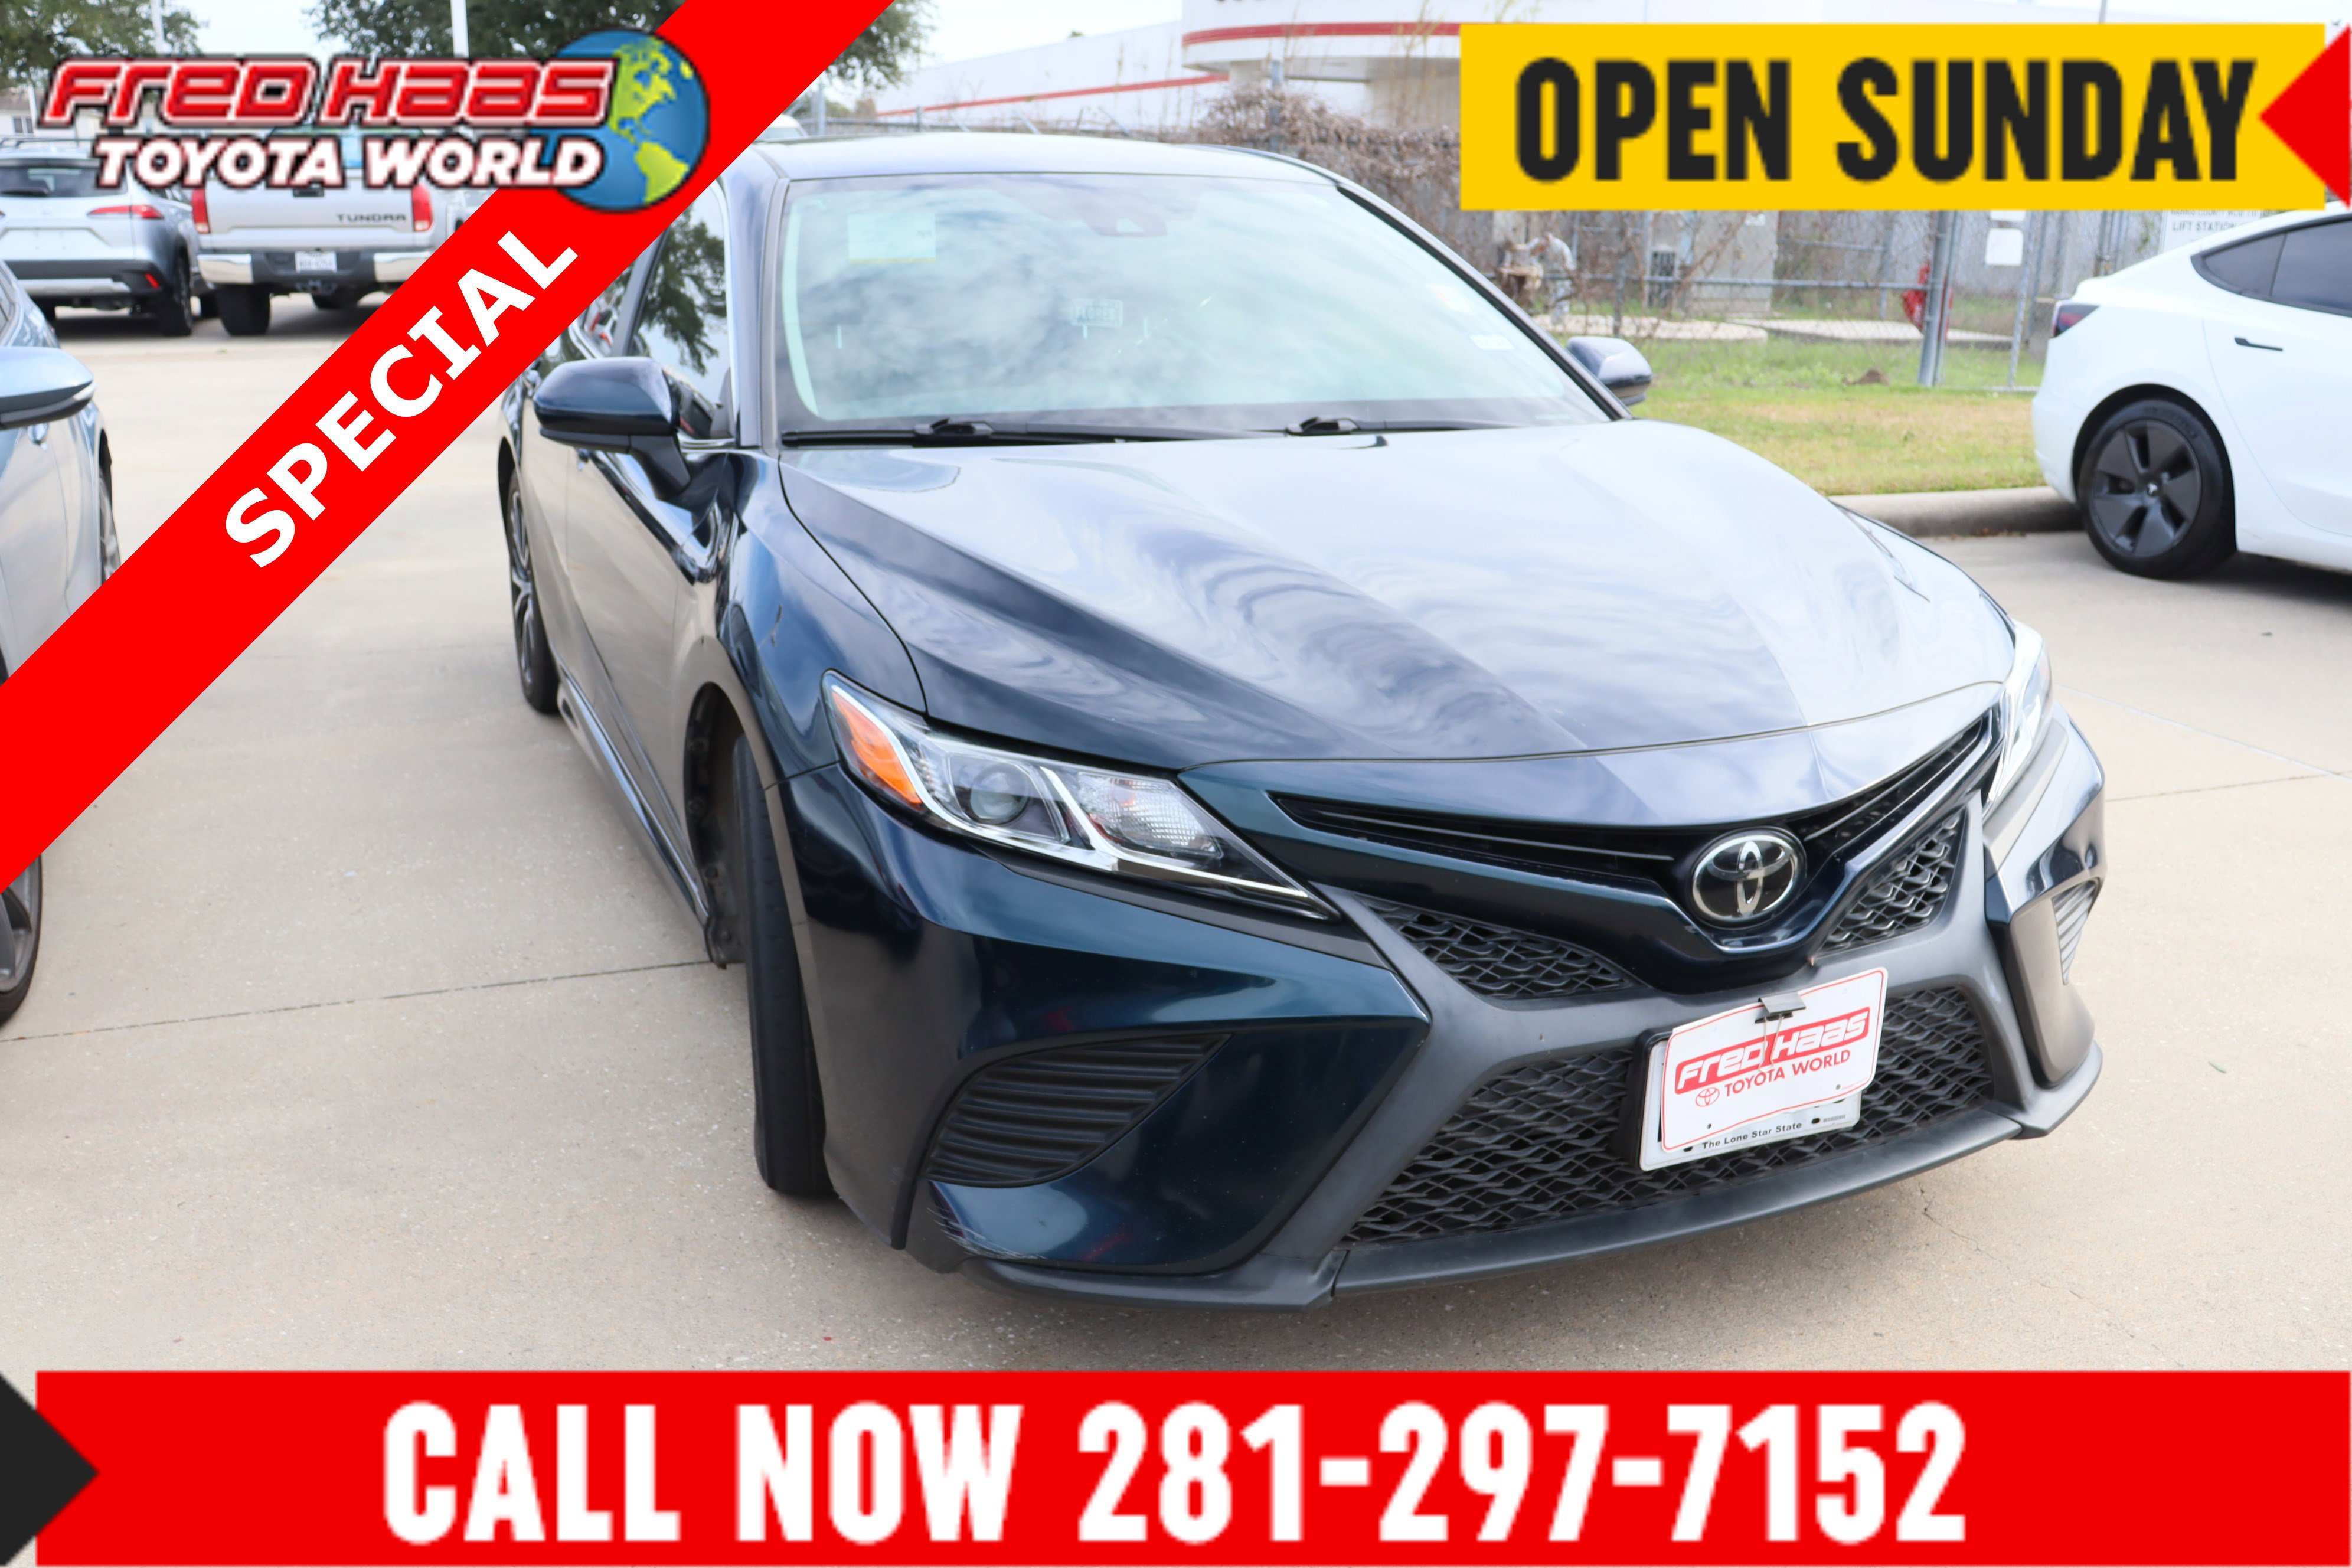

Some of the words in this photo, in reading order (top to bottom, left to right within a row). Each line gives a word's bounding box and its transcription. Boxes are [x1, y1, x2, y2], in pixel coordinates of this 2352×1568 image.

[337, 213, 406, 222] TUNDRA
[2173, 221, 2192, 231] LIFT
[1725, 1066, 1785, 1097] TOYOTA
[1792, 1049, 1851, 1076] WORLD
[1703, 1139, 1721, 1149] The
[1724, 1133, 1748, 1145] Lone
[1752, 1128, 1772, 1138] Star
[1776, 1123, 1802, 1133] State
